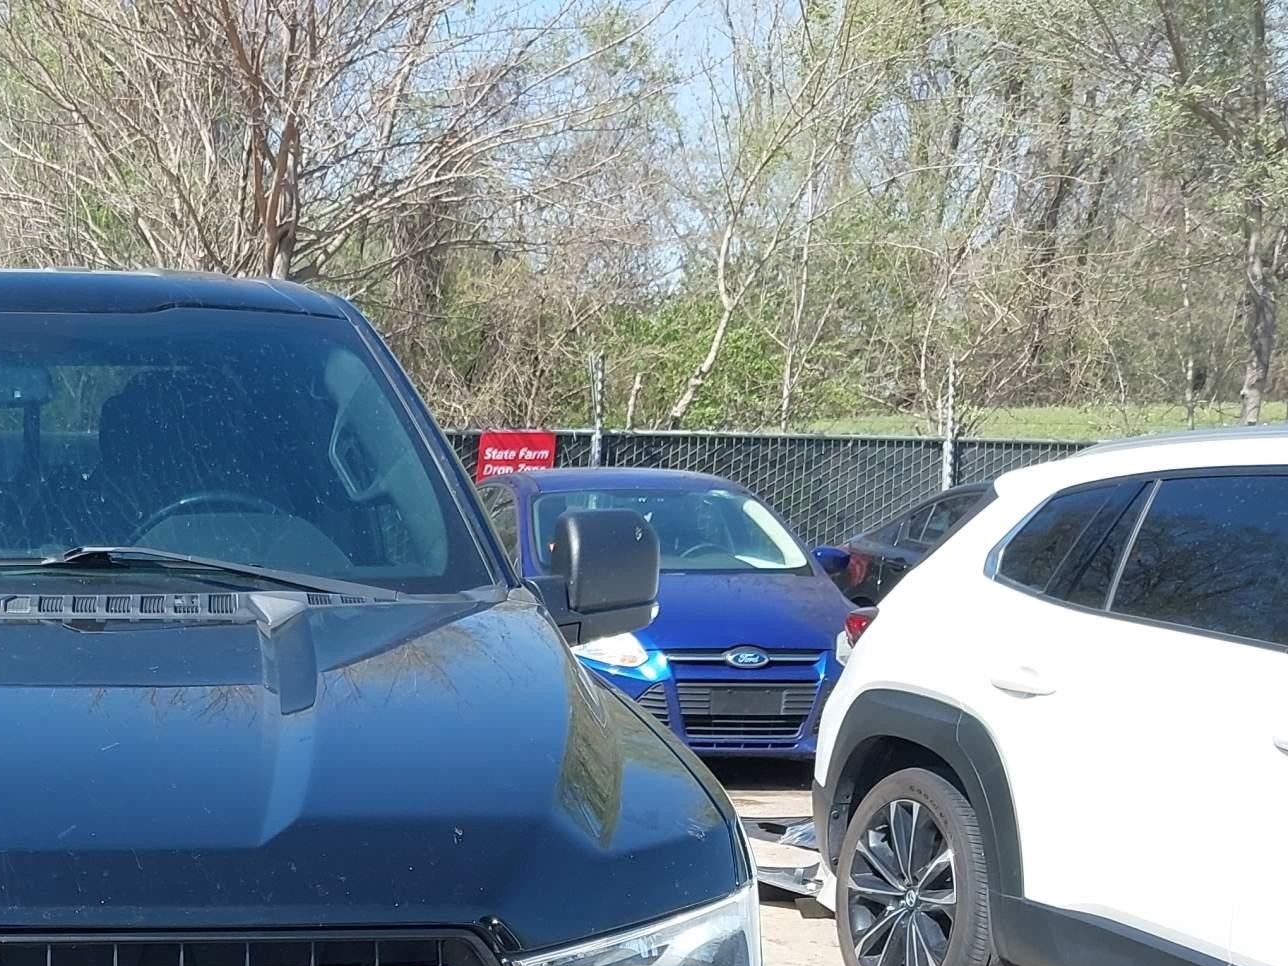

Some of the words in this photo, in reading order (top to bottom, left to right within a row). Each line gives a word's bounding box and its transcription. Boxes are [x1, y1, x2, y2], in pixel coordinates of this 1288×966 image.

[483, 447, 516, 460] State
[518, 447, 550, 460] Farm
[738, 653, 759, 663] Ford
